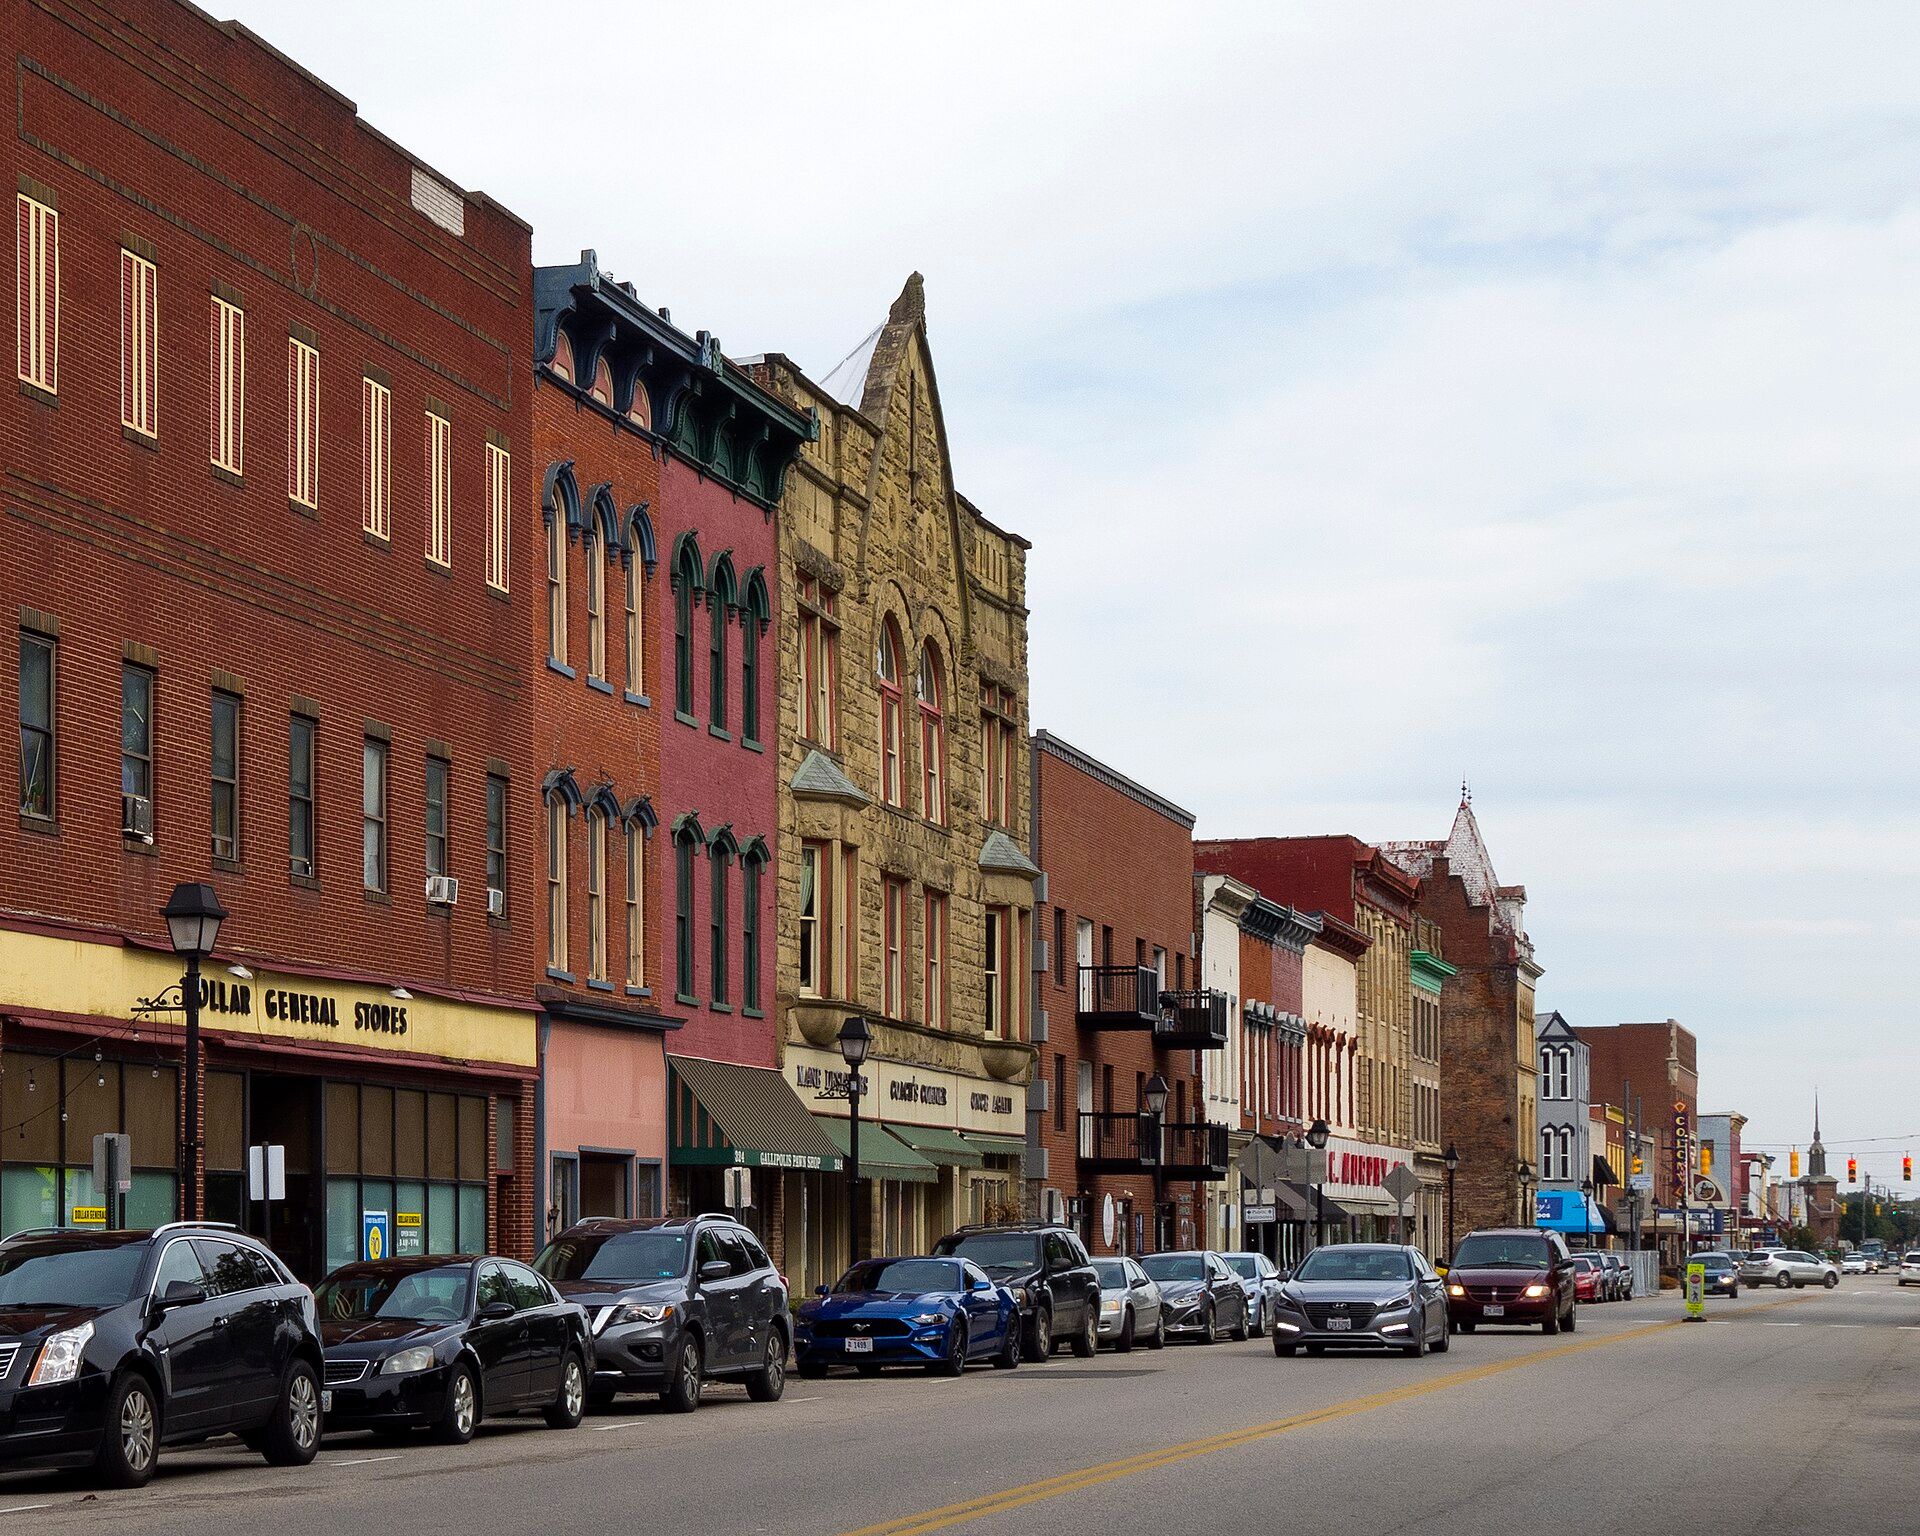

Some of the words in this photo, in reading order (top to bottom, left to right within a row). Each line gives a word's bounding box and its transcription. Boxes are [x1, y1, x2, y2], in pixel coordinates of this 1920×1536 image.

[265, 989, 339, 1027] GENERAL
[354, 1001, 407, 1035] STORES
[890, 1076, 919, 1103] COACH'S
[920, 1084, 947, 1105] CORNER
[992, 1095, 1012, 1114] AGAIN
[760, 1152, 792, 1167] GALLIPOLIS
[793, 1155, 807, 1168] PAWN
[807, 1155, 821, 1169] SHOP
[1342, 1152, 1388, 1187] MURPHY
[75, 1210, 89, 1219] DOLLAR
[398, 1215, 409, 1223] DOLLAR
[409, 1215, 421, 1223] GENERAL
